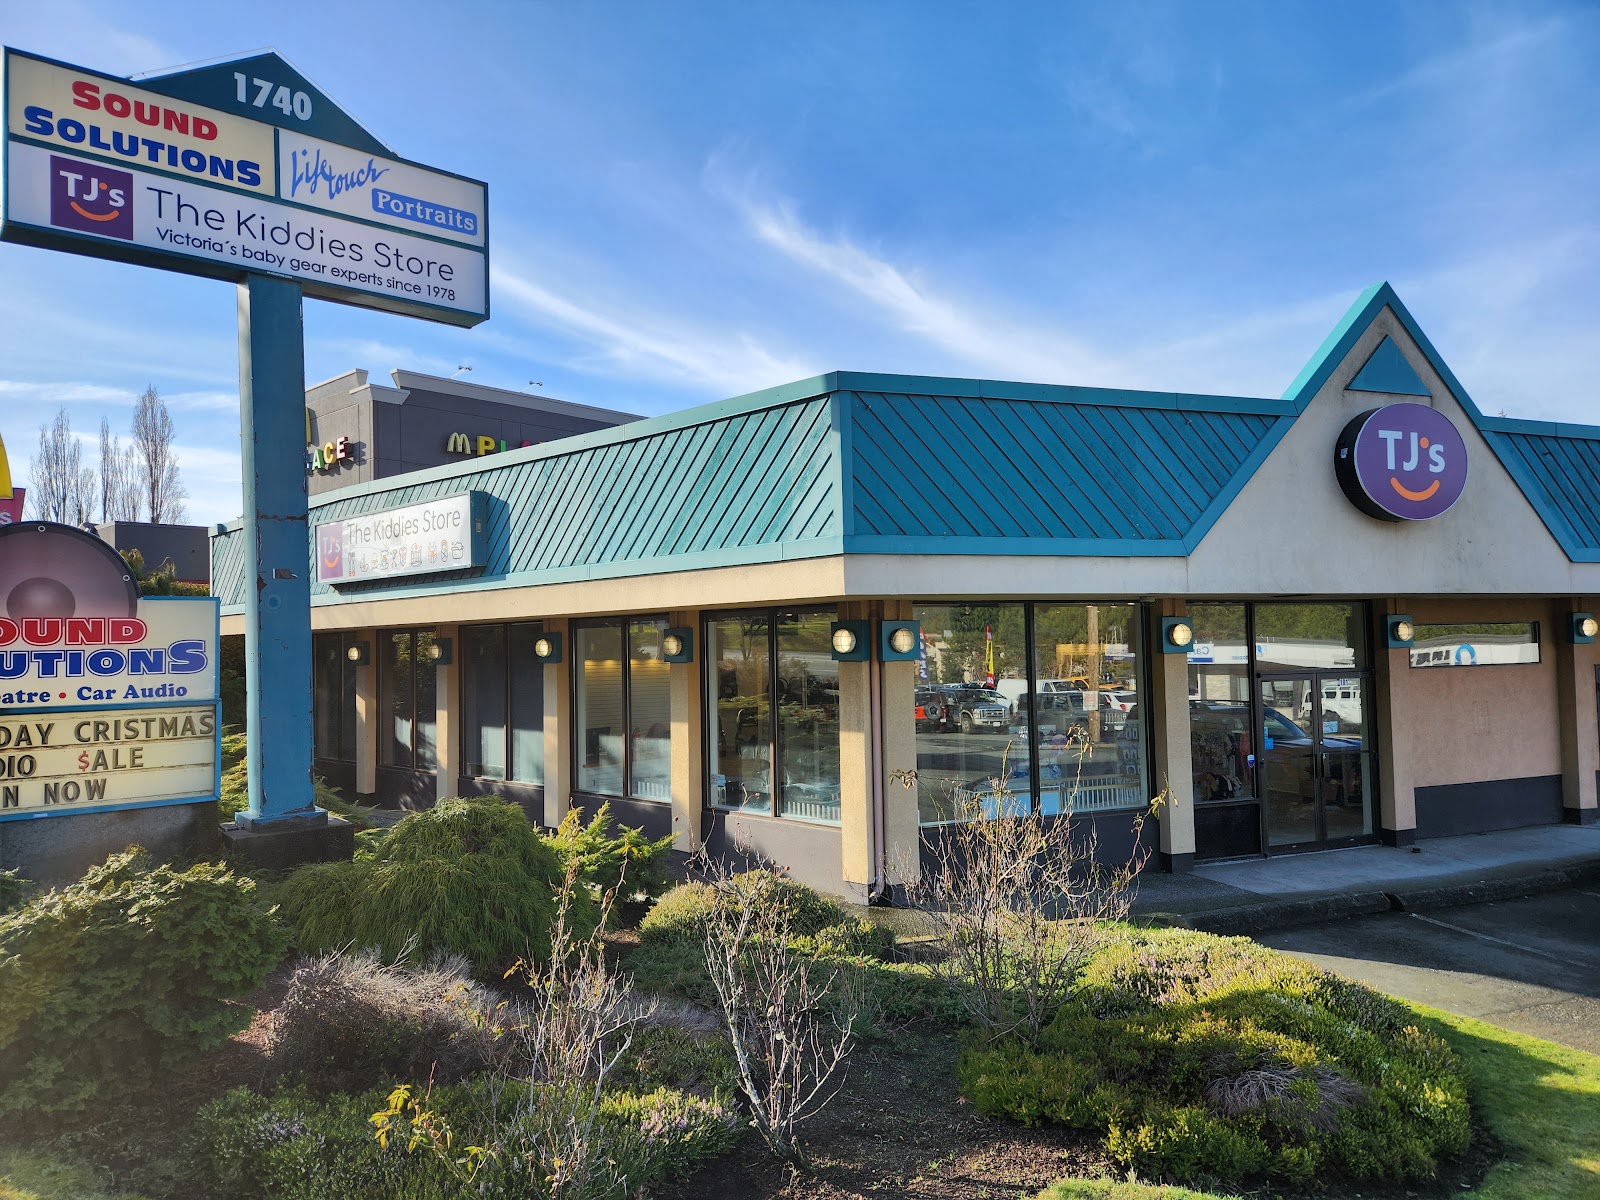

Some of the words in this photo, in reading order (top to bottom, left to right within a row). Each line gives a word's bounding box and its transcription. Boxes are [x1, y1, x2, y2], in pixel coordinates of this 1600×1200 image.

[72, 81, 218, 141] SOUND
[234, 72, 312, 121] 1740
[24, 106, 261, 187] SOLUTIONS
[59, 170, 125, 208] TJ's
[376, 191, 475, 231] Portraits
[146, 187, 225, 231] The
[237, 210, 363, 261] Kiddies
[374, 242, 454, 281] Store
[242, 245, 285, 268] baby
[290, 258, 327, 274] gear
[331, 266, 383, 286] experts
[386, 277, 421, 294] since
[427, 284, 456, 301] 1978
[1378, 429, 1446, 473] TJ's
[347, 523, 371, 545] The
[373, 513, 419, 542] Kiddies
[422, 509, 461, 533] Store
[77, 686, 117, 701] Car
[122, 683, 188, 699] Audio
[74, 714, 214, 743] CRISTMAS
[44, 778, 108, 805] NOW
